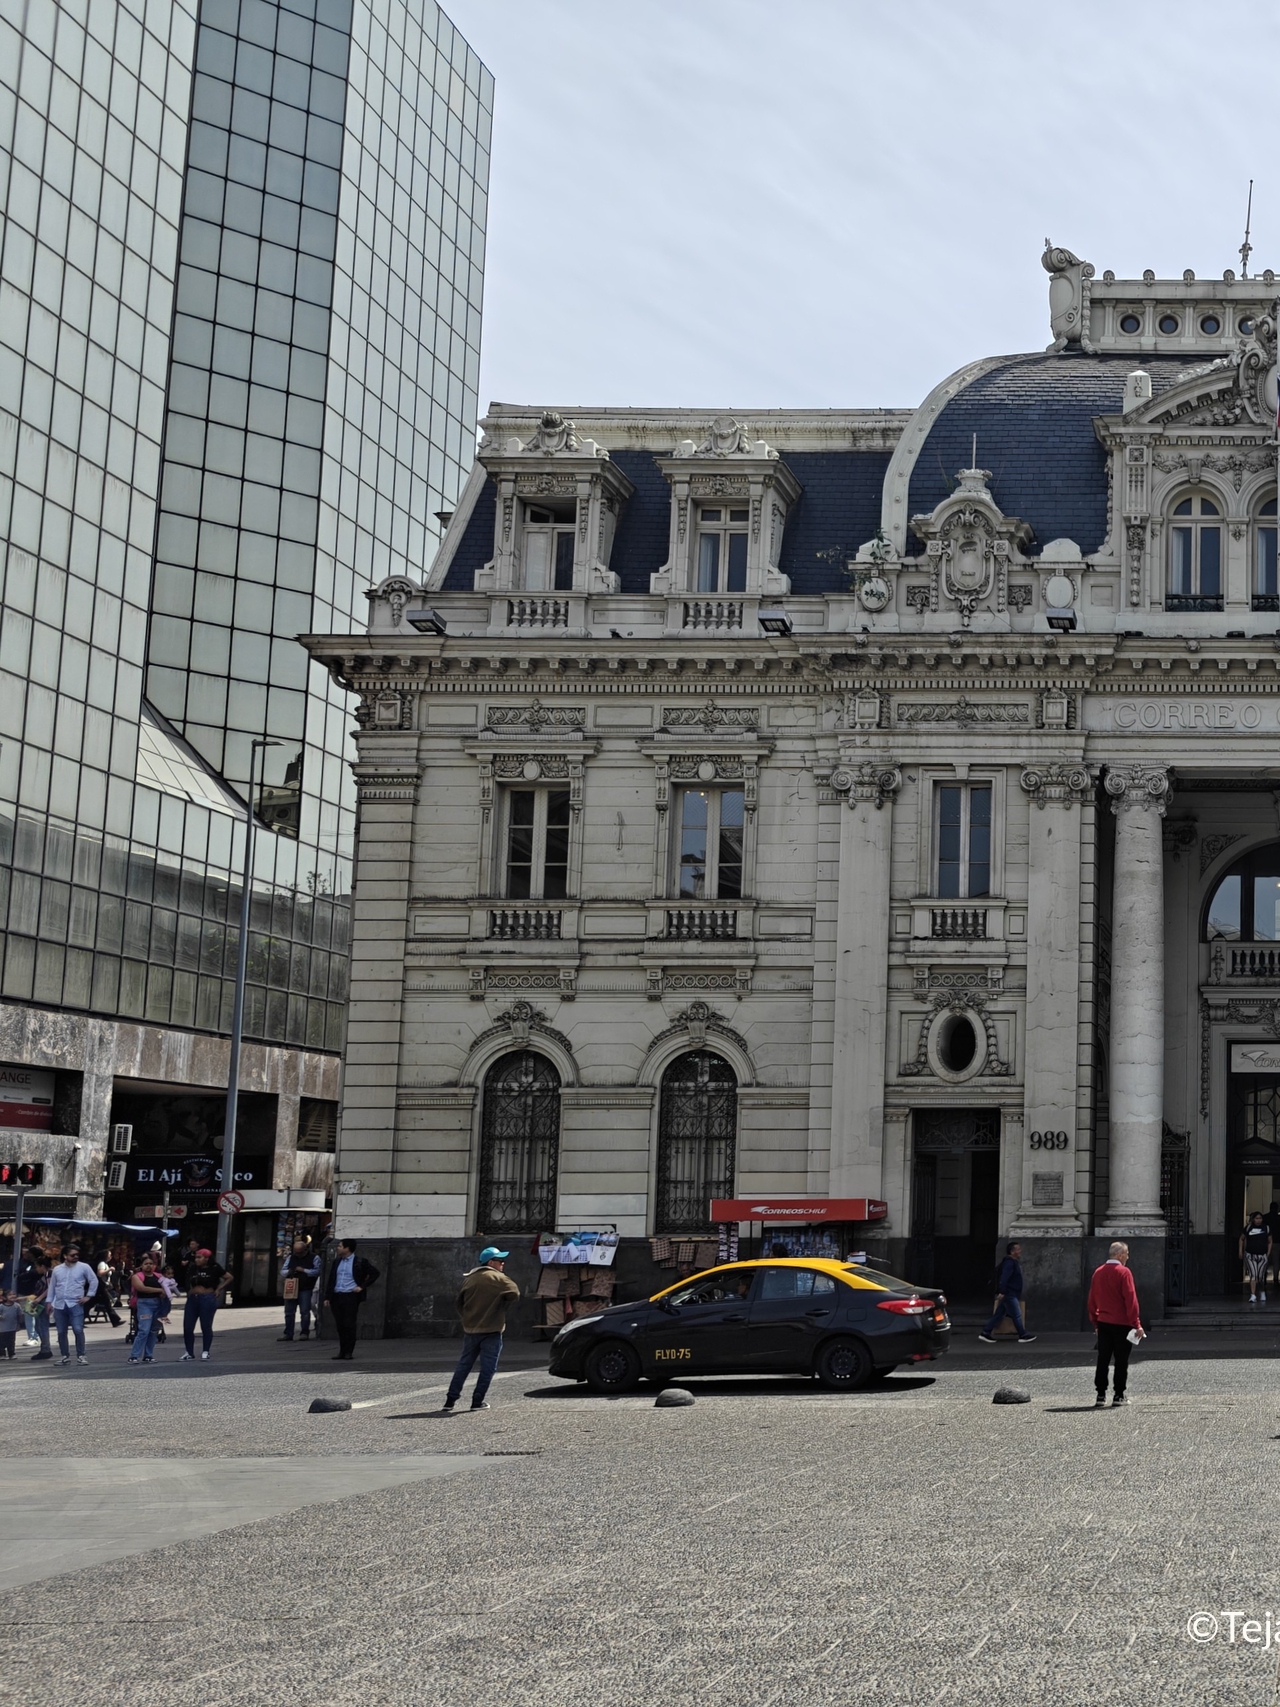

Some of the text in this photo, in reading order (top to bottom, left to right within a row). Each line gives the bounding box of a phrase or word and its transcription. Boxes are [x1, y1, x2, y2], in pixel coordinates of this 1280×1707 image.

[1113, 702, 1261, 729] CORREO
[1030, 1130, 1069, 1150] 989
[137, 1168, 253, 1185] El Ají Sco
